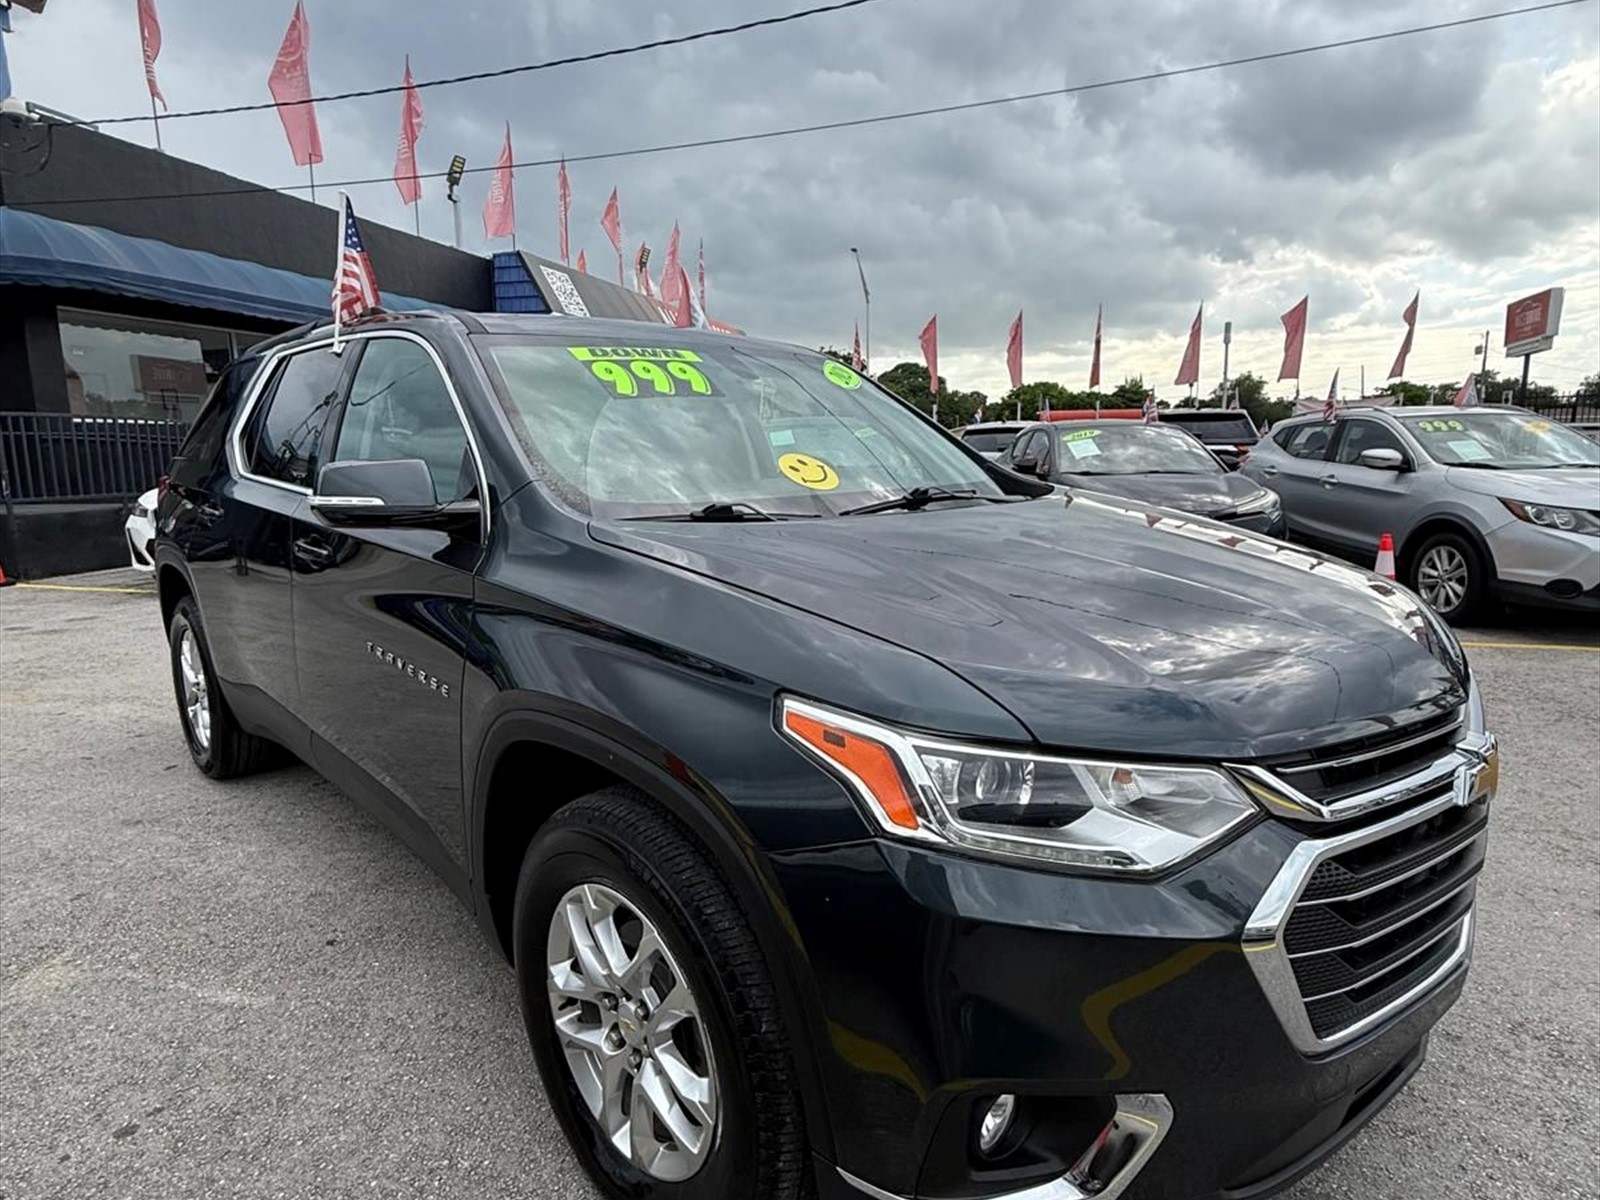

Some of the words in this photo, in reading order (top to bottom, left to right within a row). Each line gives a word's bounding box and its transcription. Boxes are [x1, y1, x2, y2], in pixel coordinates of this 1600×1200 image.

[588, 348, 685, 358] DOWN
[590, 360, 713, 397] 999
[1417, 419, 1465, 432] 999
[366, 642, 449, 697] TRAVERSE
